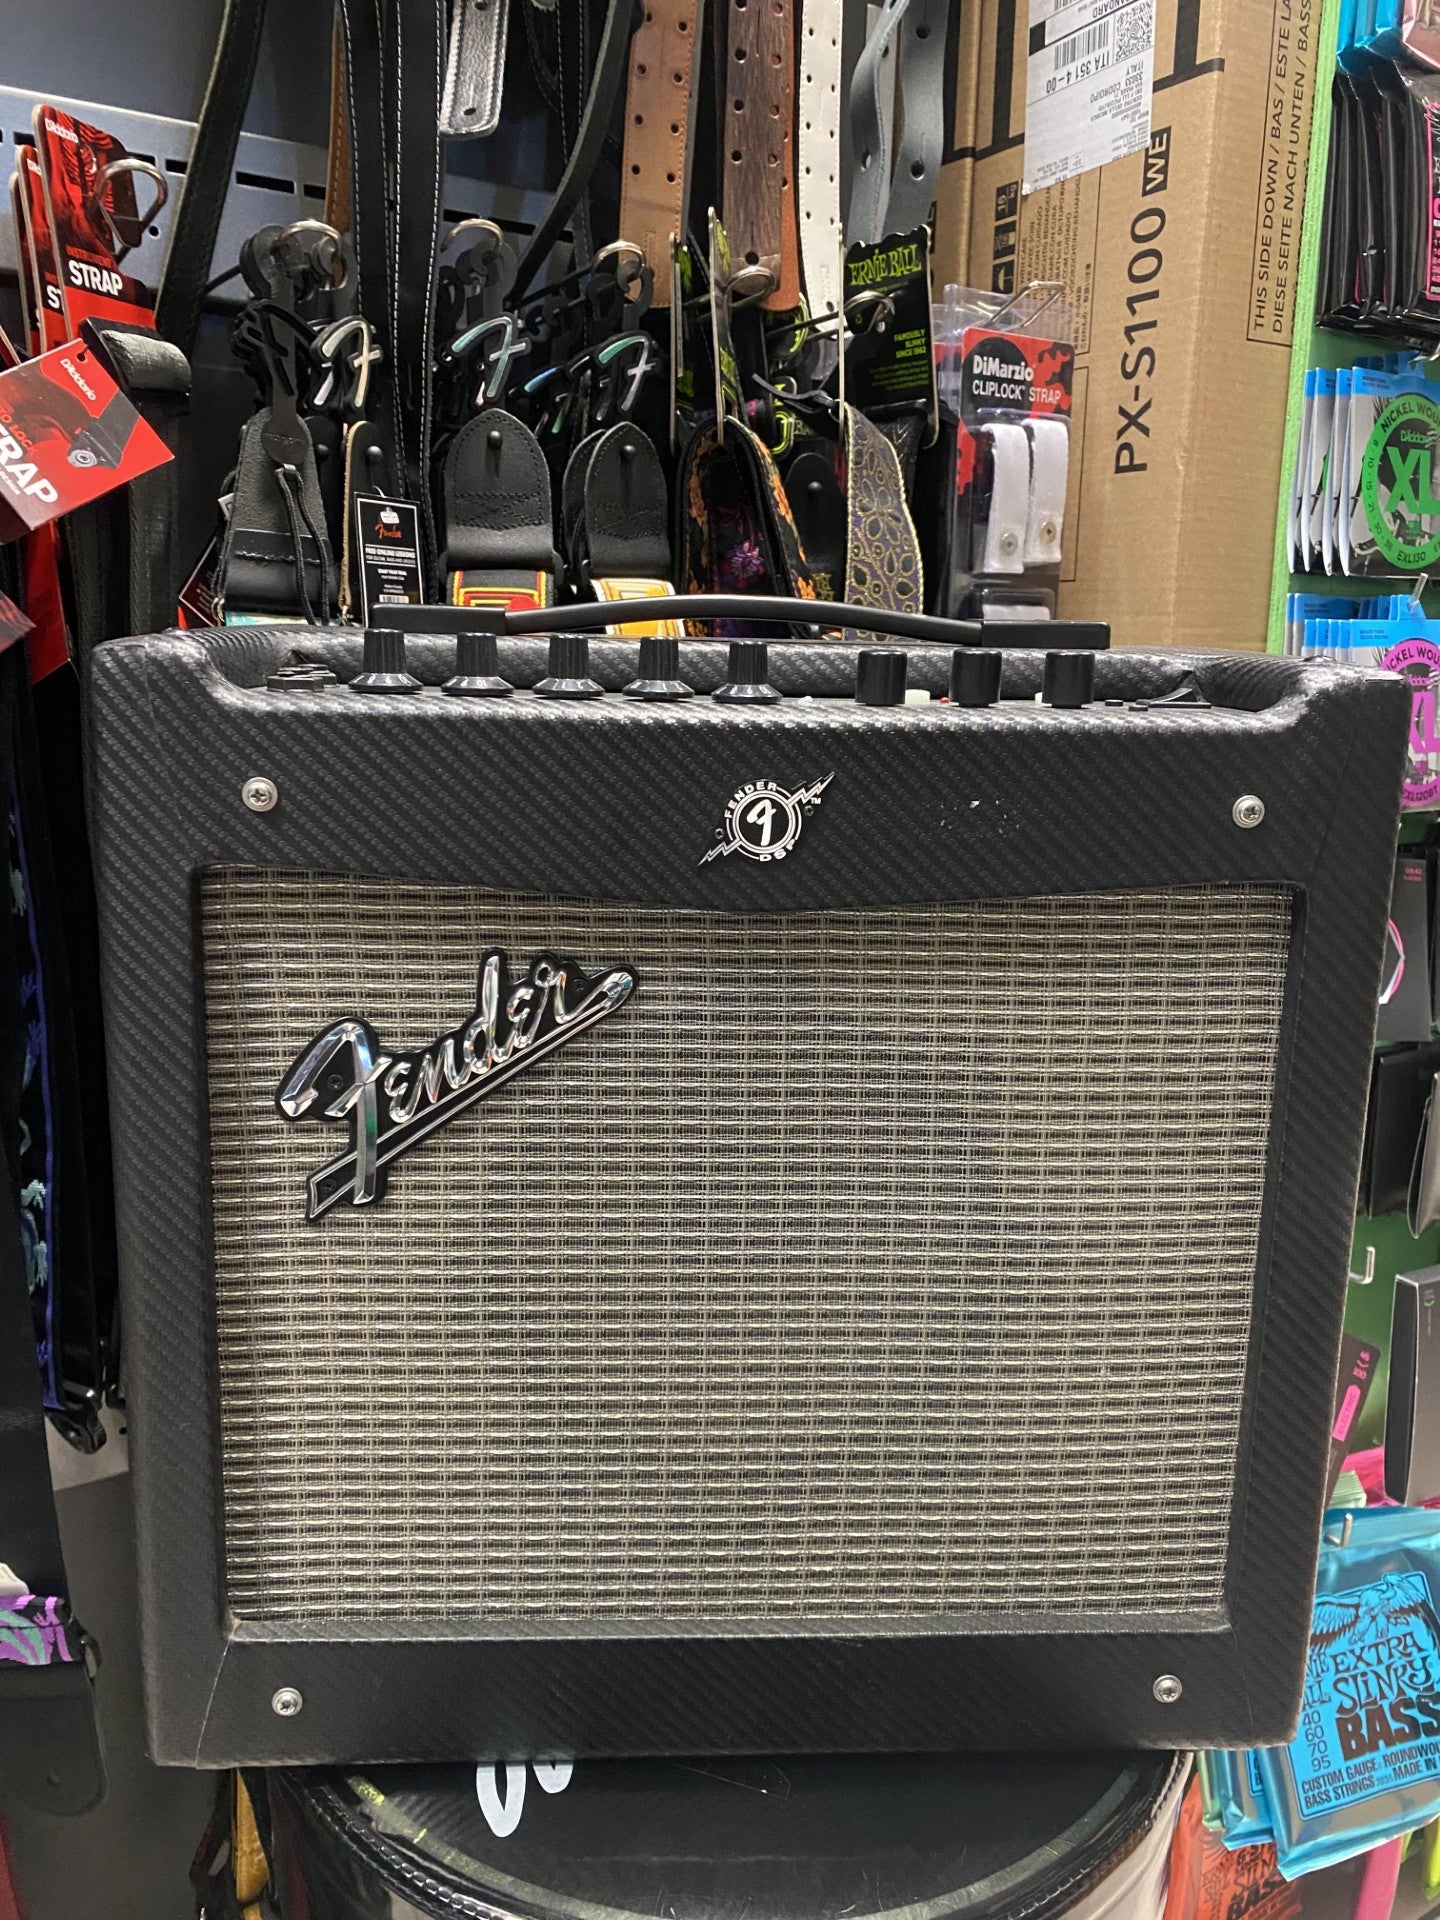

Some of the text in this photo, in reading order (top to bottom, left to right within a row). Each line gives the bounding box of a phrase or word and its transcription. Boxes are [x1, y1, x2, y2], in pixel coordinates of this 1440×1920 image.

[1075, 60, 1092, 80] 351
[1094, 50, 1110, 71] ITA
[1126, 60, 1144, 76] ITALY
[1276, 26, 1290, 78] ESTE
[1271, 98, 1284, 139] BAS
[1290, 72, 1305, 144] UNTEN
[1145, 133, 1168, 191] WE
[1284, 151, 1298, 210] NACH
[1263, 159, 1279, 229] DOWN
[1258, 235, 1272, 281] SIDE
[1278, 216, 1292, 270] SEITE
[68, 259, 123, 296] STRAP
[848, 244, 922, 286] ERNIE BALL
[1254, 288, 1267, 331] THIS
[1273, 277, 1287, 333] DIESE
[1114, 207, 1167, 475] PX-S1100
[972, 354, 1034, 382] DiMarzio
[1029, 387, 1061, 403] STRAP
[1381, 401, 1414, 433] NICKEL
[1384, 446, 1440, 515] XL
[1387, 647, 1414, 670] ICKEL
[724, 781, 778, 819] FENDER
[759, 838, 796, 862] DSP
[280, 954, 635, 1220] Fender
[1329, 1631, 1427, 1677] EXTRA
[1332, 1655, 1435, 1714] SLINKY
[1302, 1709, 1321, 1726] 40
[1305, 1724, 1324, 1743] 60
[1335, 1693, 1440, 1762] BASS
[1308, 1740, 1328, 1758] 70
[1311, 1754, 1331, 1772] 95
[1301, 1768, 1344, 1795] CUSTOM
[1346, 1757, 1377, 1780] GAUGE
[1304, 1790, 1332, 1810] BASS
[1332, 1775, 1375, 1801] STRINGS
[1392, 1762, 1422, 1780] MADE
[1424, 1757, 1437, 1771] IN
